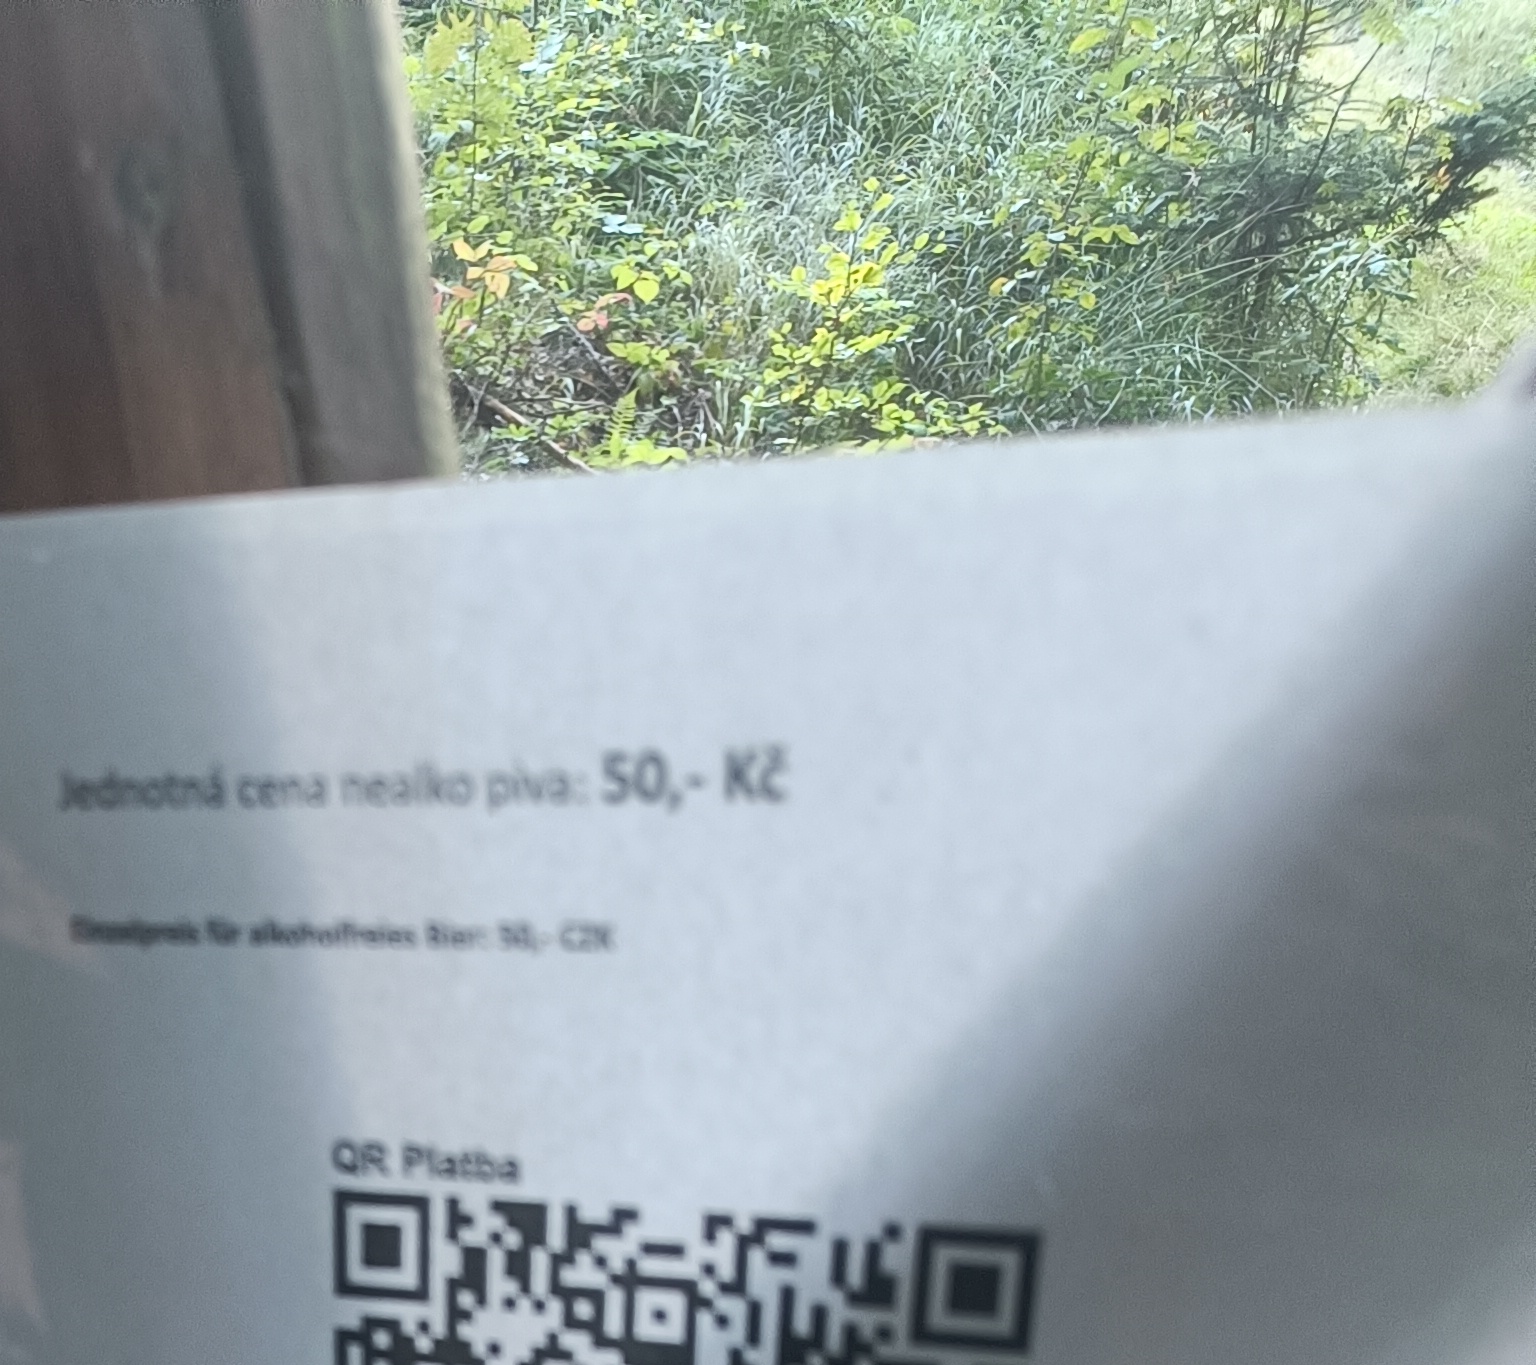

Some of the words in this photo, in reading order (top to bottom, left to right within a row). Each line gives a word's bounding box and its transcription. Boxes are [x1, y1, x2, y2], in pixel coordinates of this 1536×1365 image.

[236, 773, 328, 810] cena
[342, 762, 472, 806] nealko
[486, 768, 588, 815] piva:
[722, 743, 791, 803] Kč
[332, 1138, 387, 1176] QR
[401, 1143, 522, 1184] Platba
